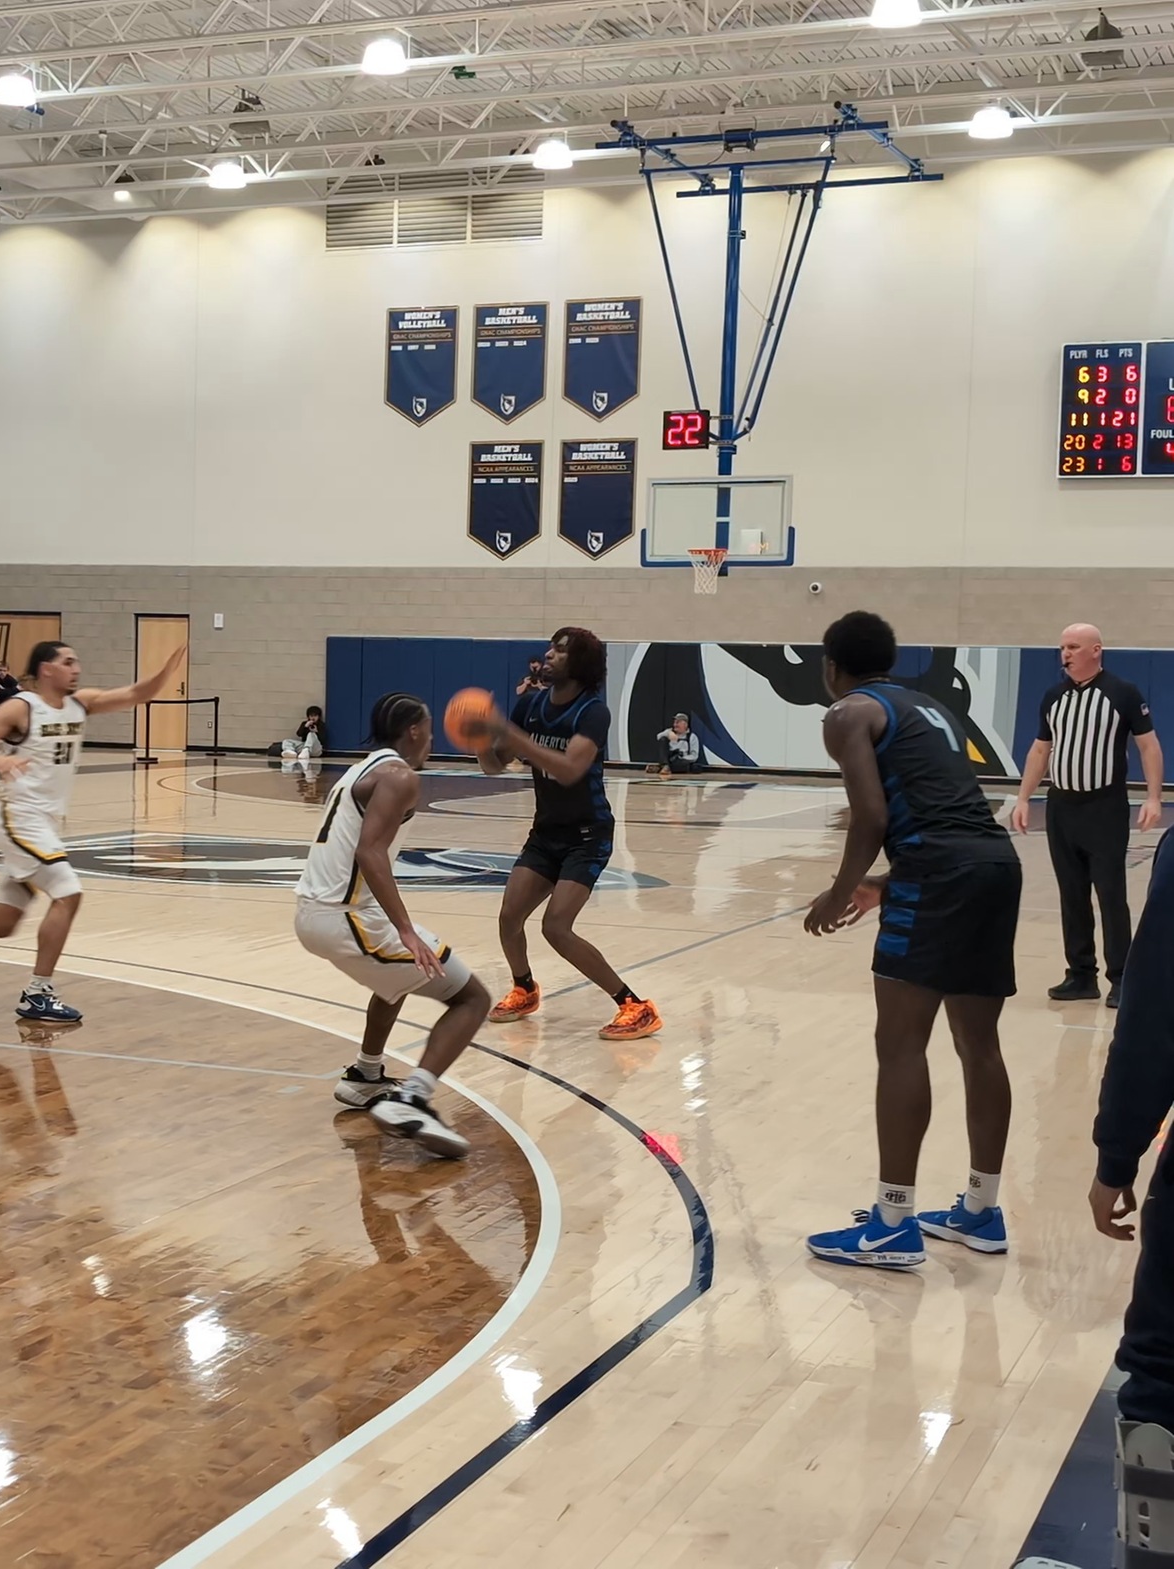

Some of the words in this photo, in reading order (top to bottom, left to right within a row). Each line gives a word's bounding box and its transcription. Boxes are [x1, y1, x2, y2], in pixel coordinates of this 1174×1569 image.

[484, 316, 538, 325] BASKETBALL
[576, 311, 631, 321] BASKETBALL
[1069, 350, 1088, 359] PLYR
[1095, 349, 1109, 358] FLS
[1118, 348, 1133, 358] PTS
[1078, 366, 1090, 383] 6
[1097, 366, 1107, 382] 3
[1126, 365, 1137, 381] 6
[1078, 388, 1089, 404] 9
[1095, 388, 1106, 405] 2
[1125, 388, 1137, 404] 0
[1071, 412, 1088, 427] 11
[1100, 412, 1106, 426] 1
[1112, 411, 1135, 427] 21
[667, 415, 702, 445] 22
[1150, 429, 1174, 439] FOUL
[1063, 434, 1086, 450] 20
[1092, 434, 1104, 449] 2
[1116, 433, 1133, 449] 13
[480, 453, 533, 462] BASKETBALL
[571, 452, 626, 460] BASKETBALL
[1062, 457, 1085, 472] 23
[1121, 456, 1132, 472] 6
[914, 705, 961, 752] 4
